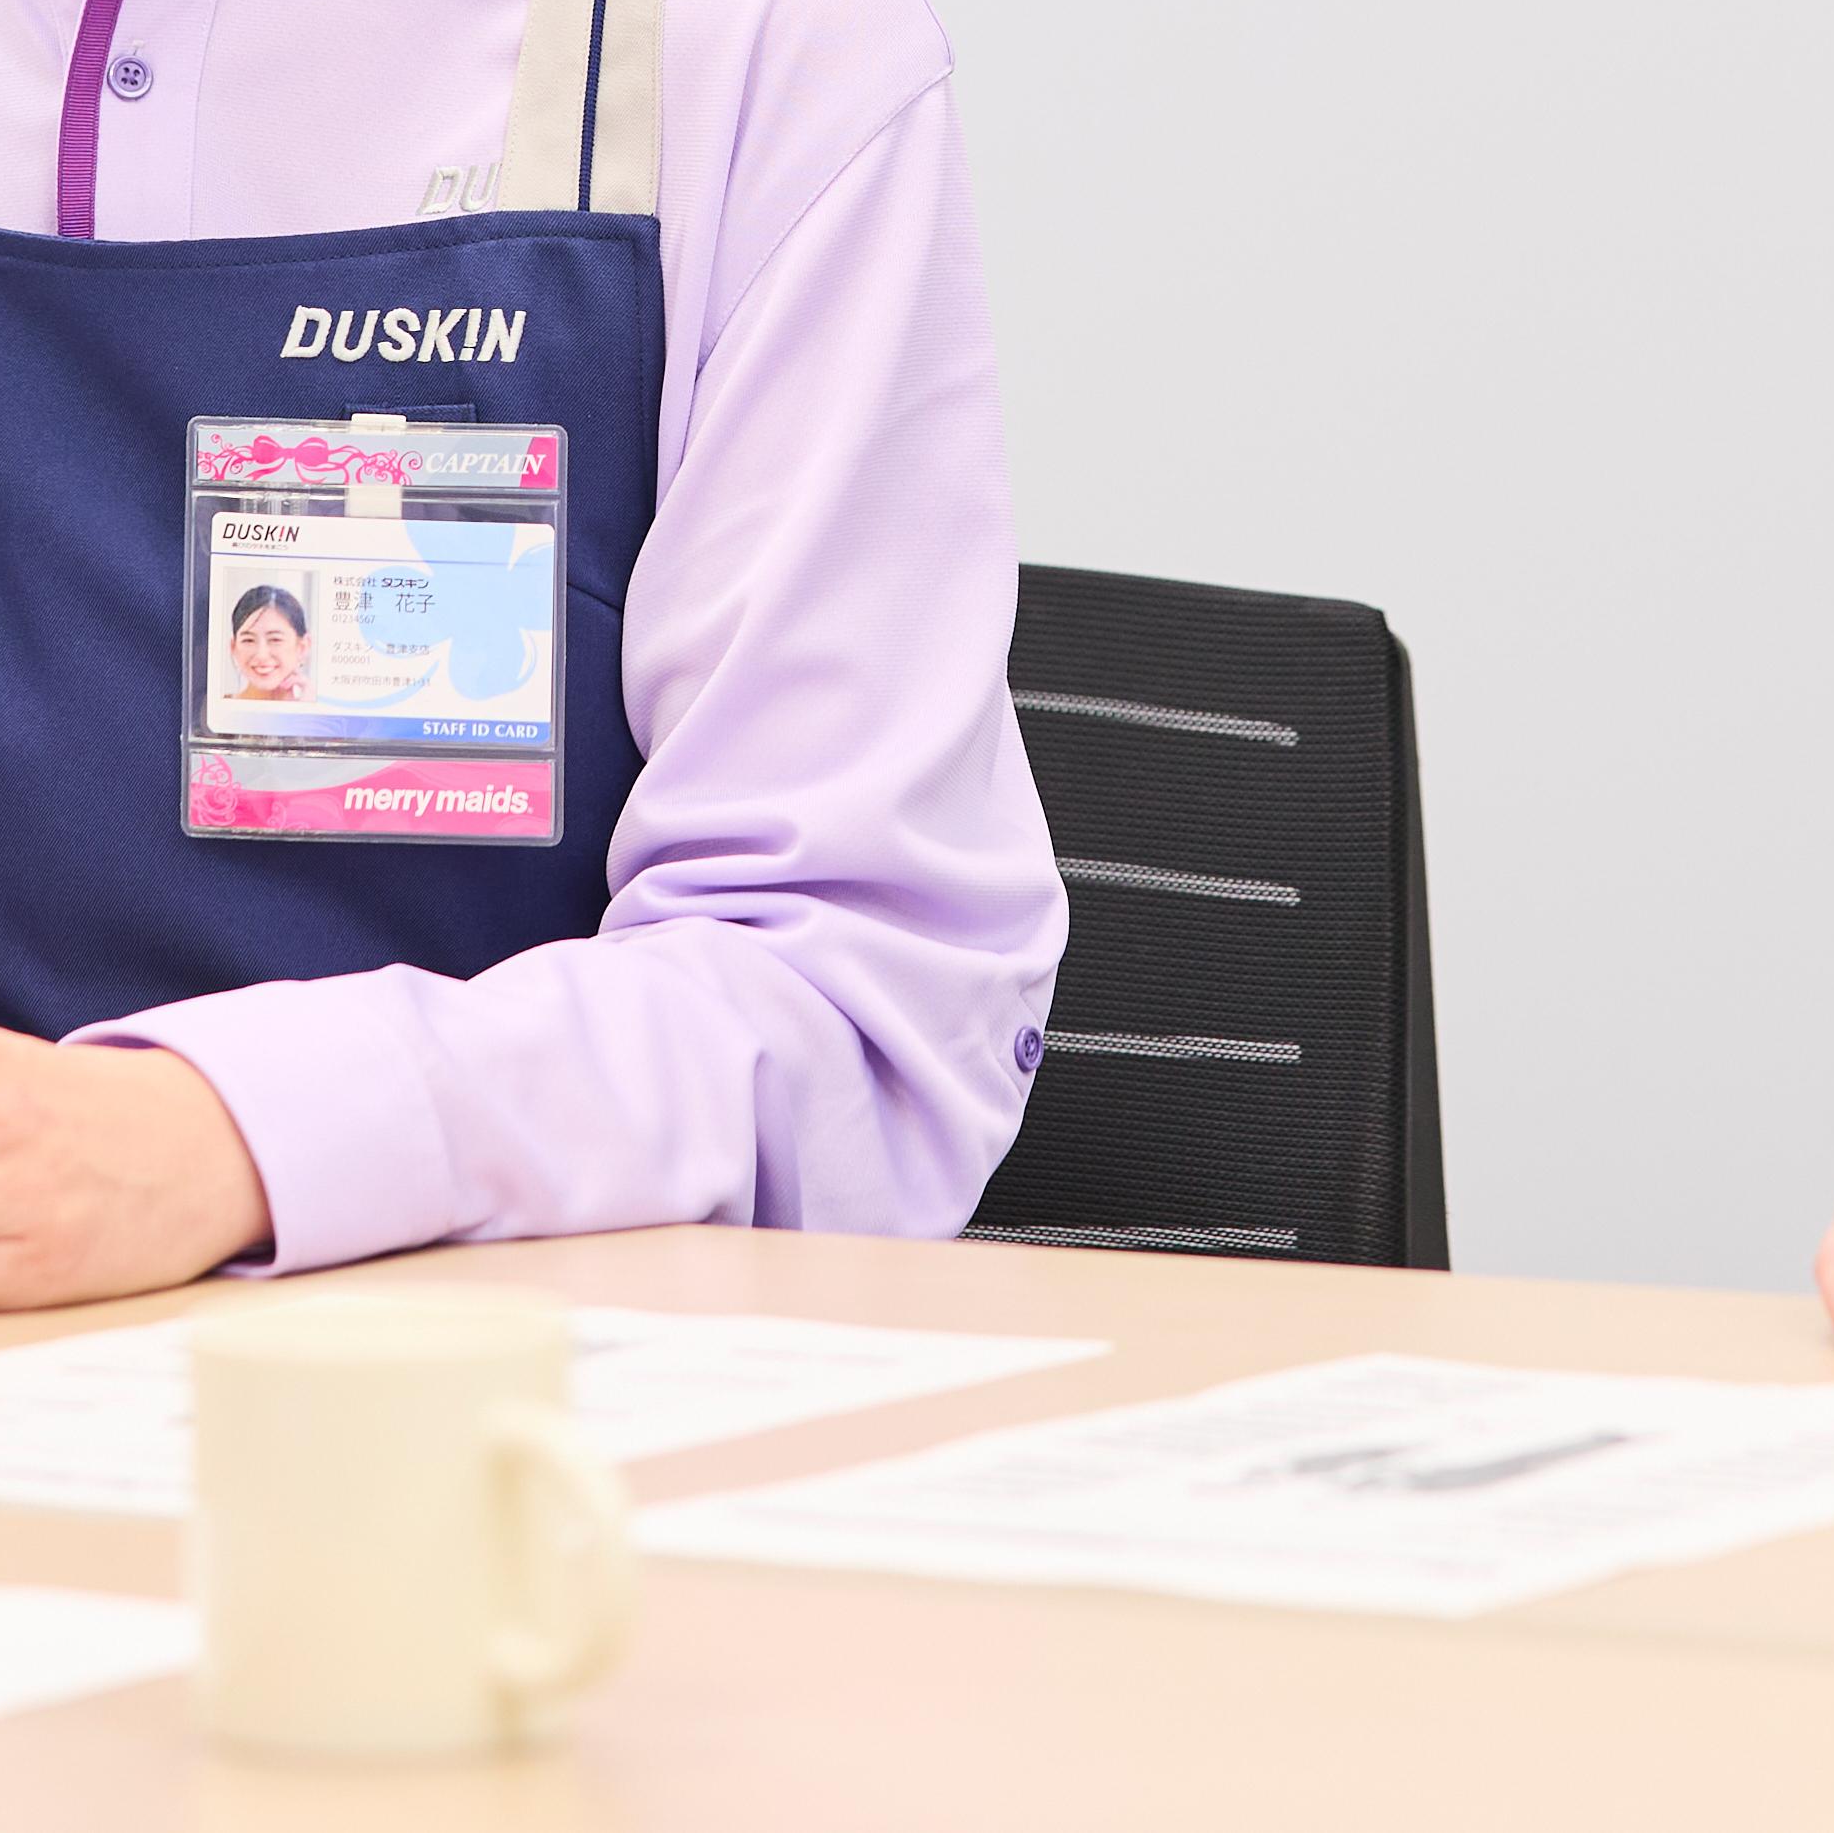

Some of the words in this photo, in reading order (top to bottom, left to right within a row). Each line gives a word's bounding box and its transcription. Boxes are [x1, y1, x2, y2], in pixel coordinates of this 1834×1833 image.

[425, 451, 547, 476] CAPTAIN
[333, 576, 377, 587] 株式会社
[333, 590, 375, 612] 豊津
[395, 592, 436, 614] 花子
[422, 721, 467, 736] STAFF
[471, 723, 491, 737] ID
[494, 724, 539, 739] CARD
[344, 787, 434, 817] merry
